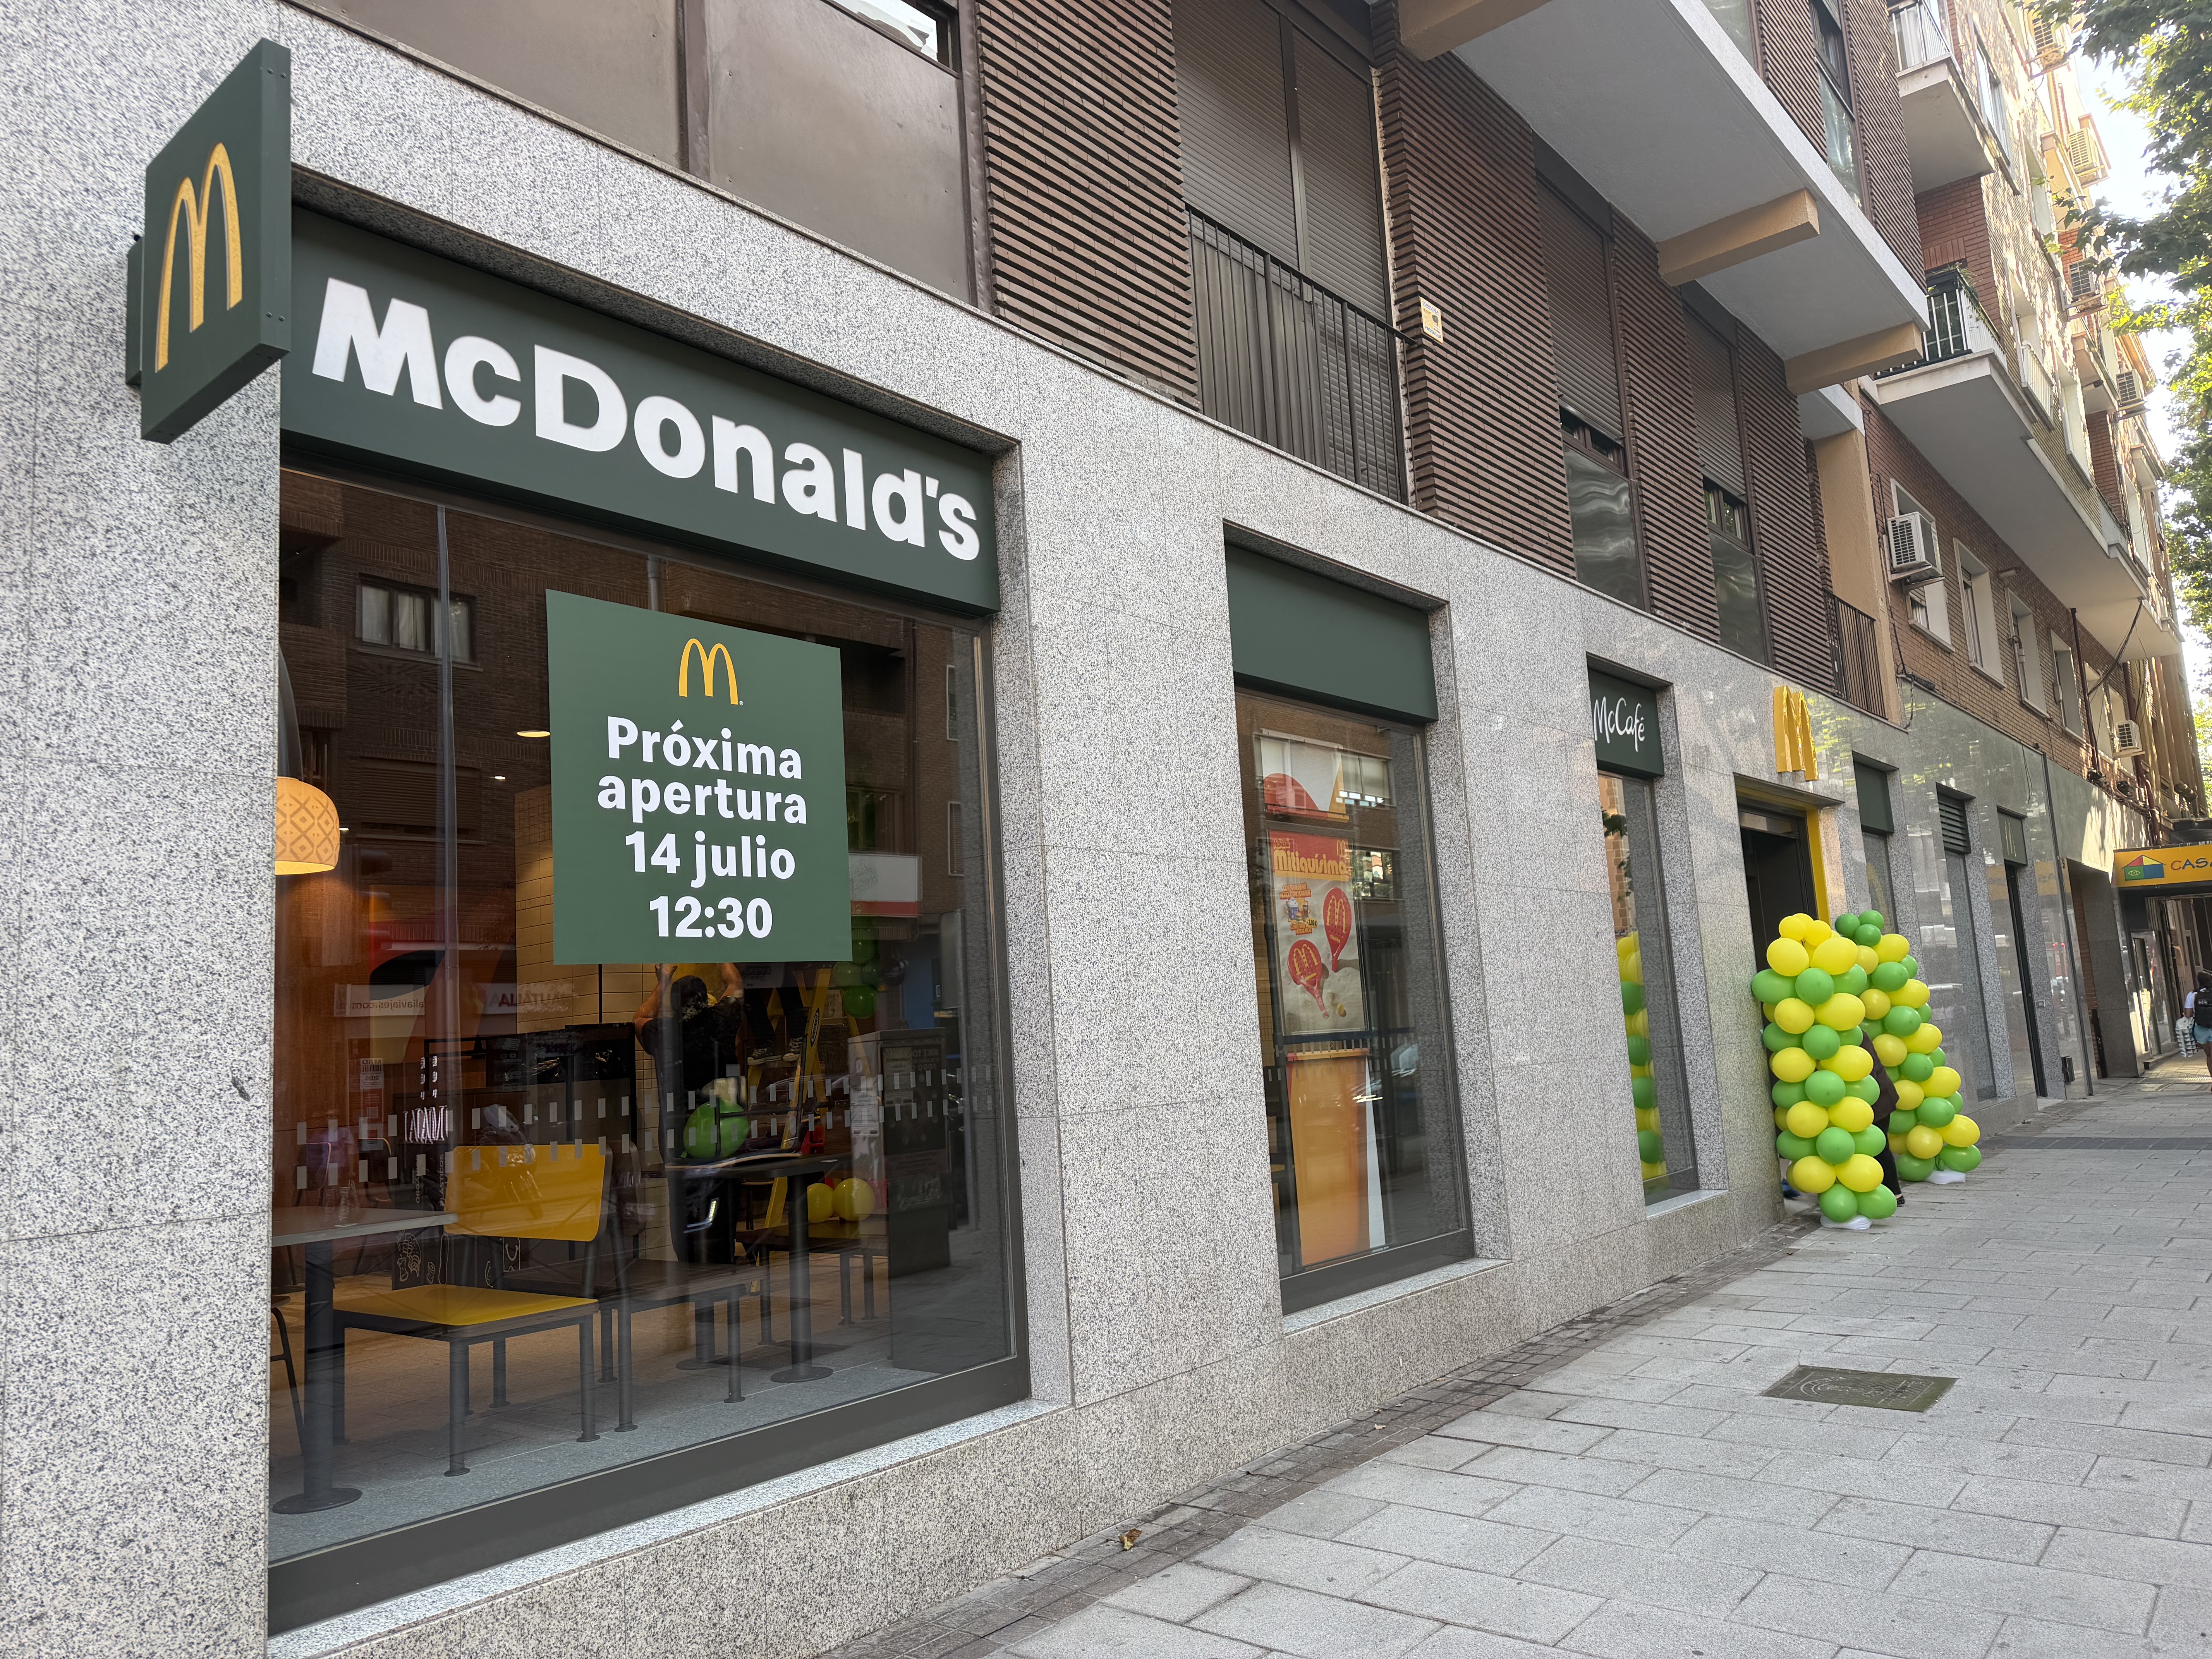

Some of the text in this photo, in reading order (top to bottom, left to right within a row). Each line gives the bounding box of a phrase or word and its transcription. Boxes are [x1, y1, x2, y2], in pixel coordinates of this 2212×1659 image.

[313, 277, 980, 561] McDonald's
[608, 716, 802, 779] Próxima
[1593, 696, 1645, 752] McCafé
[598, 775, 807, 824] apertura
[625, 830, 795, 888] 14 julio
[1273, 850, 1347, 875] Mitiquísimo
[2171, 858, 2212, 870] CAS
[649, 896, 772, 938] 12:30
